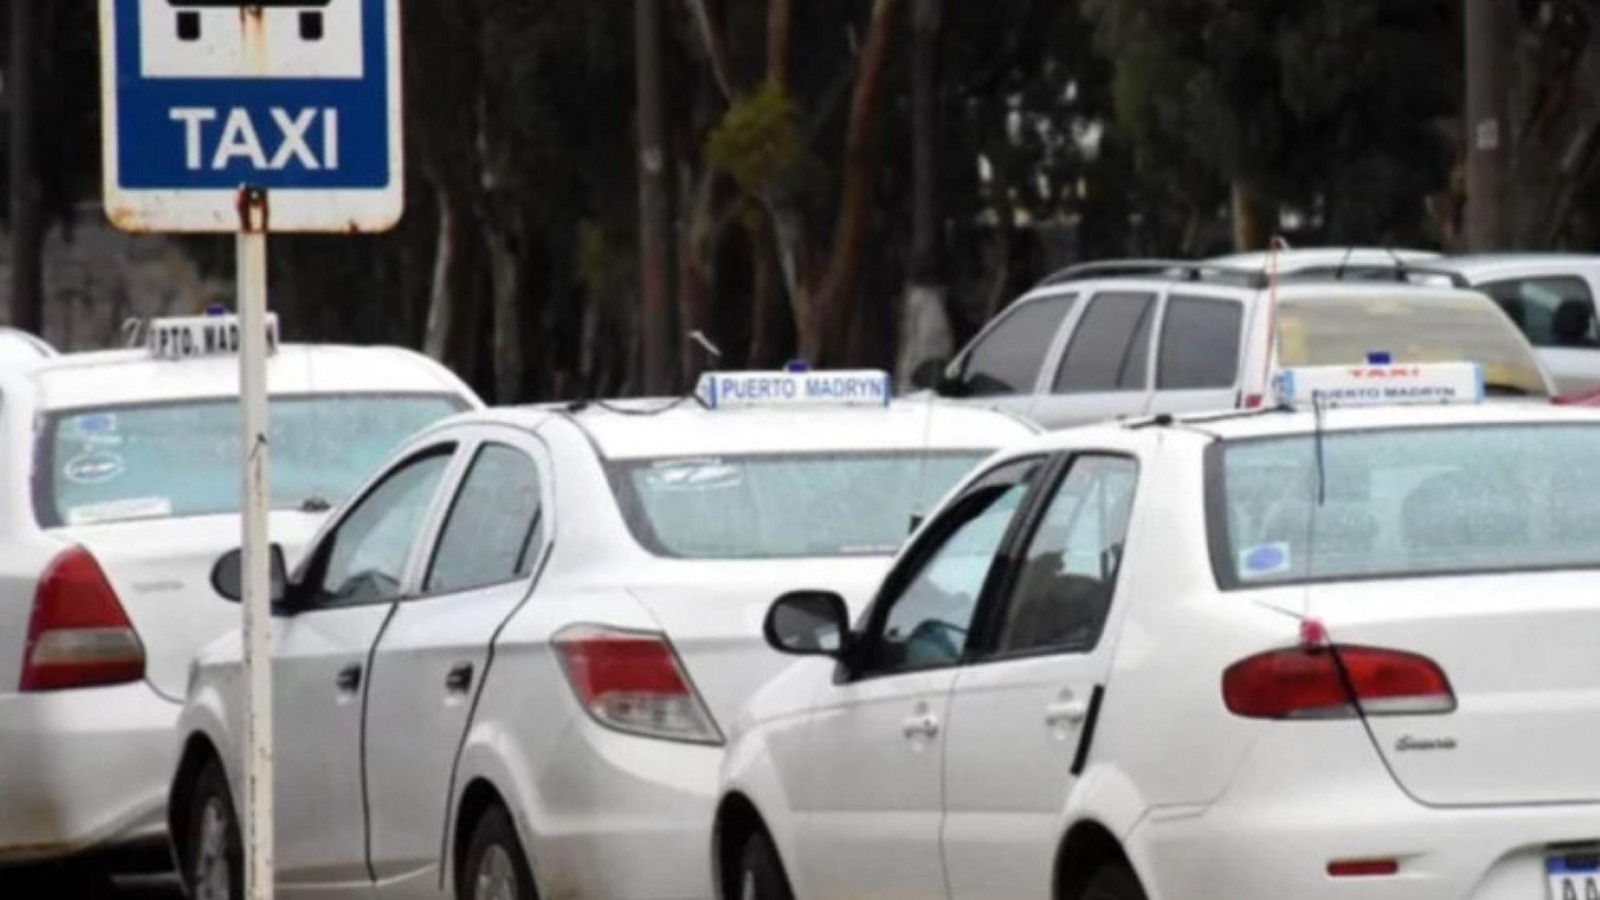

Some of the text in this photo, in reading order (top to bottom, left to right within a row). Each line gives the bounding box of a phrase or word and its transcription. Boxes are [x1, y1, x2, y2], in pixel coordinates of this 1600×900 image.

[168, 106, 339, 170] TAXI
[1349, 368, 1420, 378] TAXI
[721, 376, 883, 399] PUERTO MADRYN
[1384, 386, 1456, 397] MADRYN
